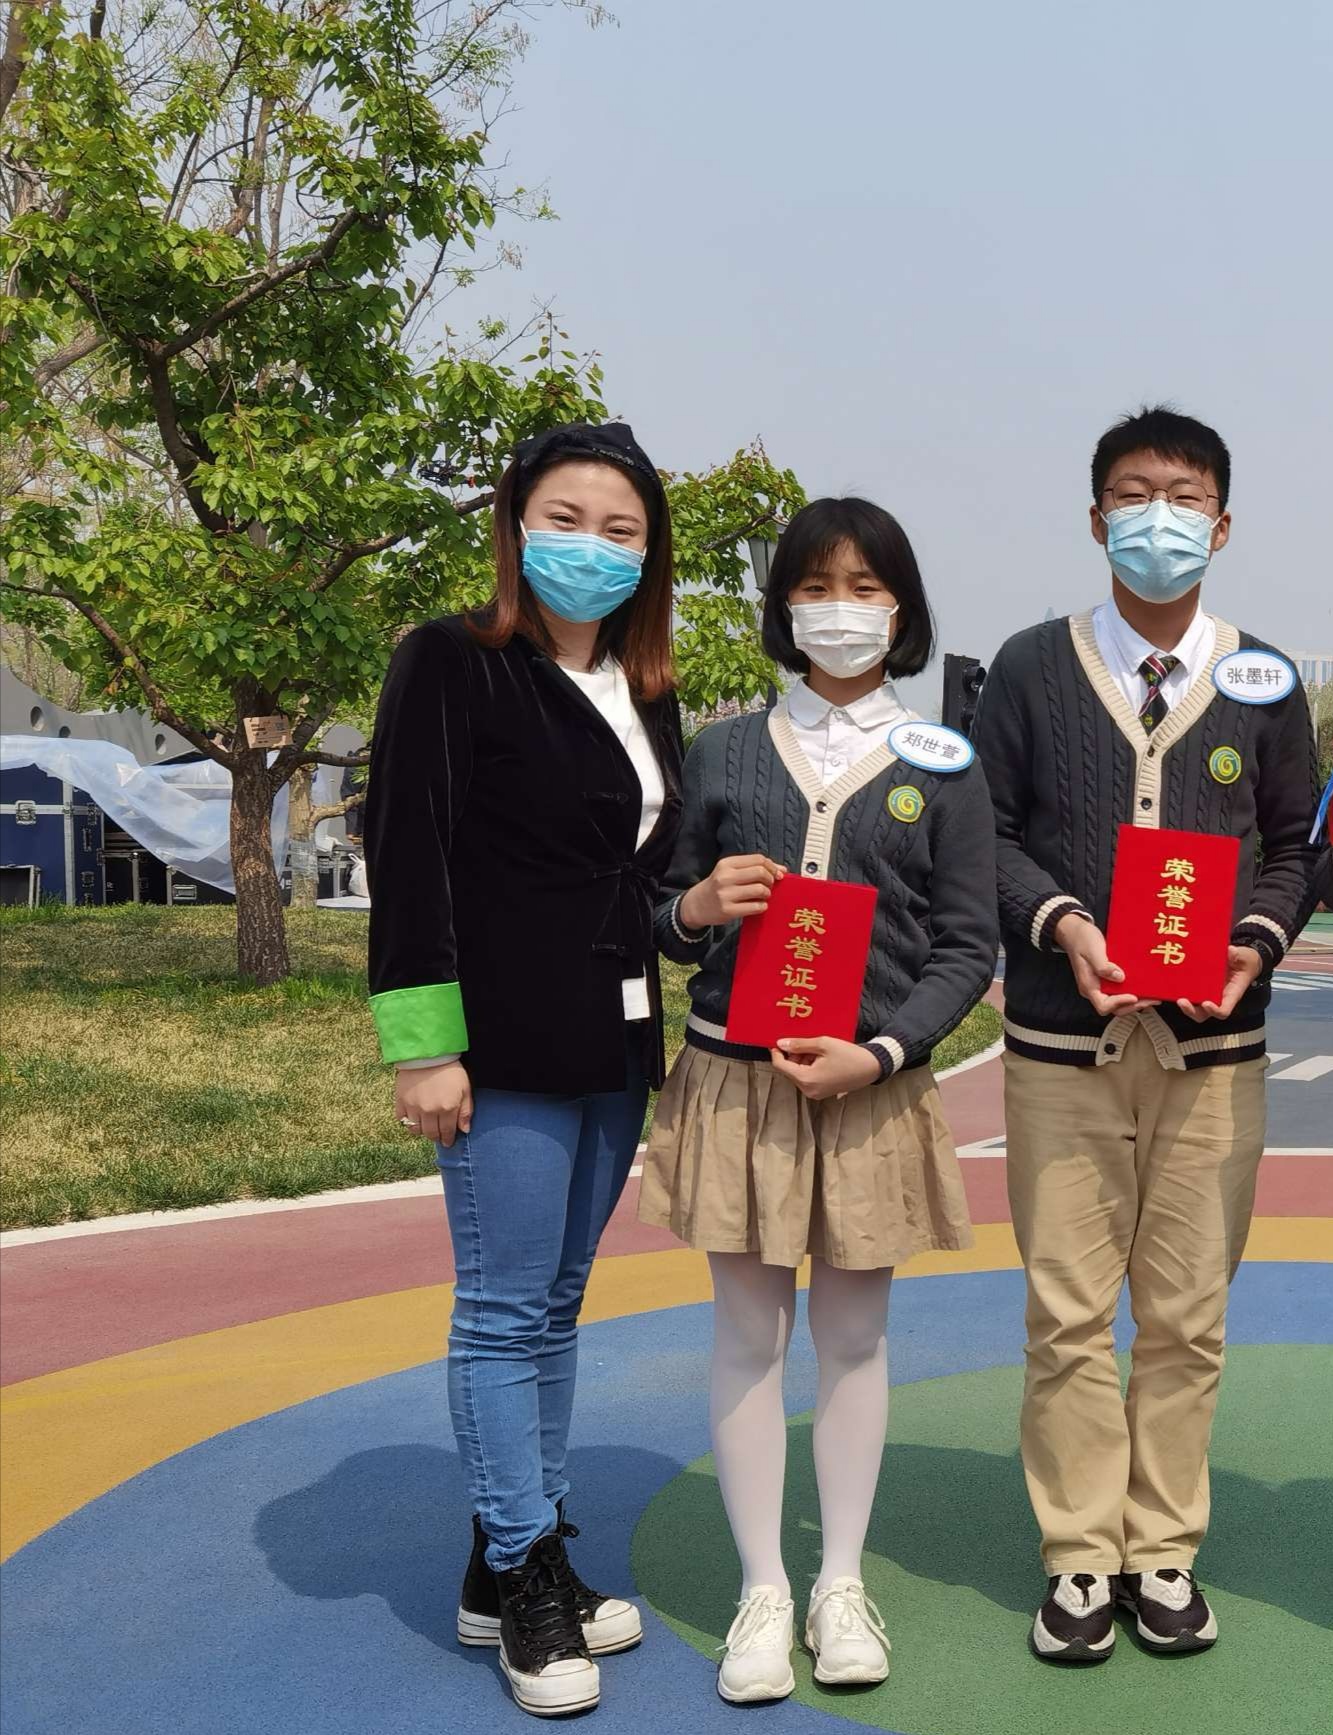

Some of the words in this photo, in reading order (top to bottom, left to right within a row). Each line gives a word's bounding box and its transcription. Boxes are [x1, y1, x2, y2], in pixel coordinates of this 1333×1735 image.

[1227, 667, 1282, 686] 张墨轩
[902, 731, 960, 760] 郑世萱
[1150, 858, 1197, 966] 荣誉证书
[776, 907, 826, 1019] 荣誉证书
